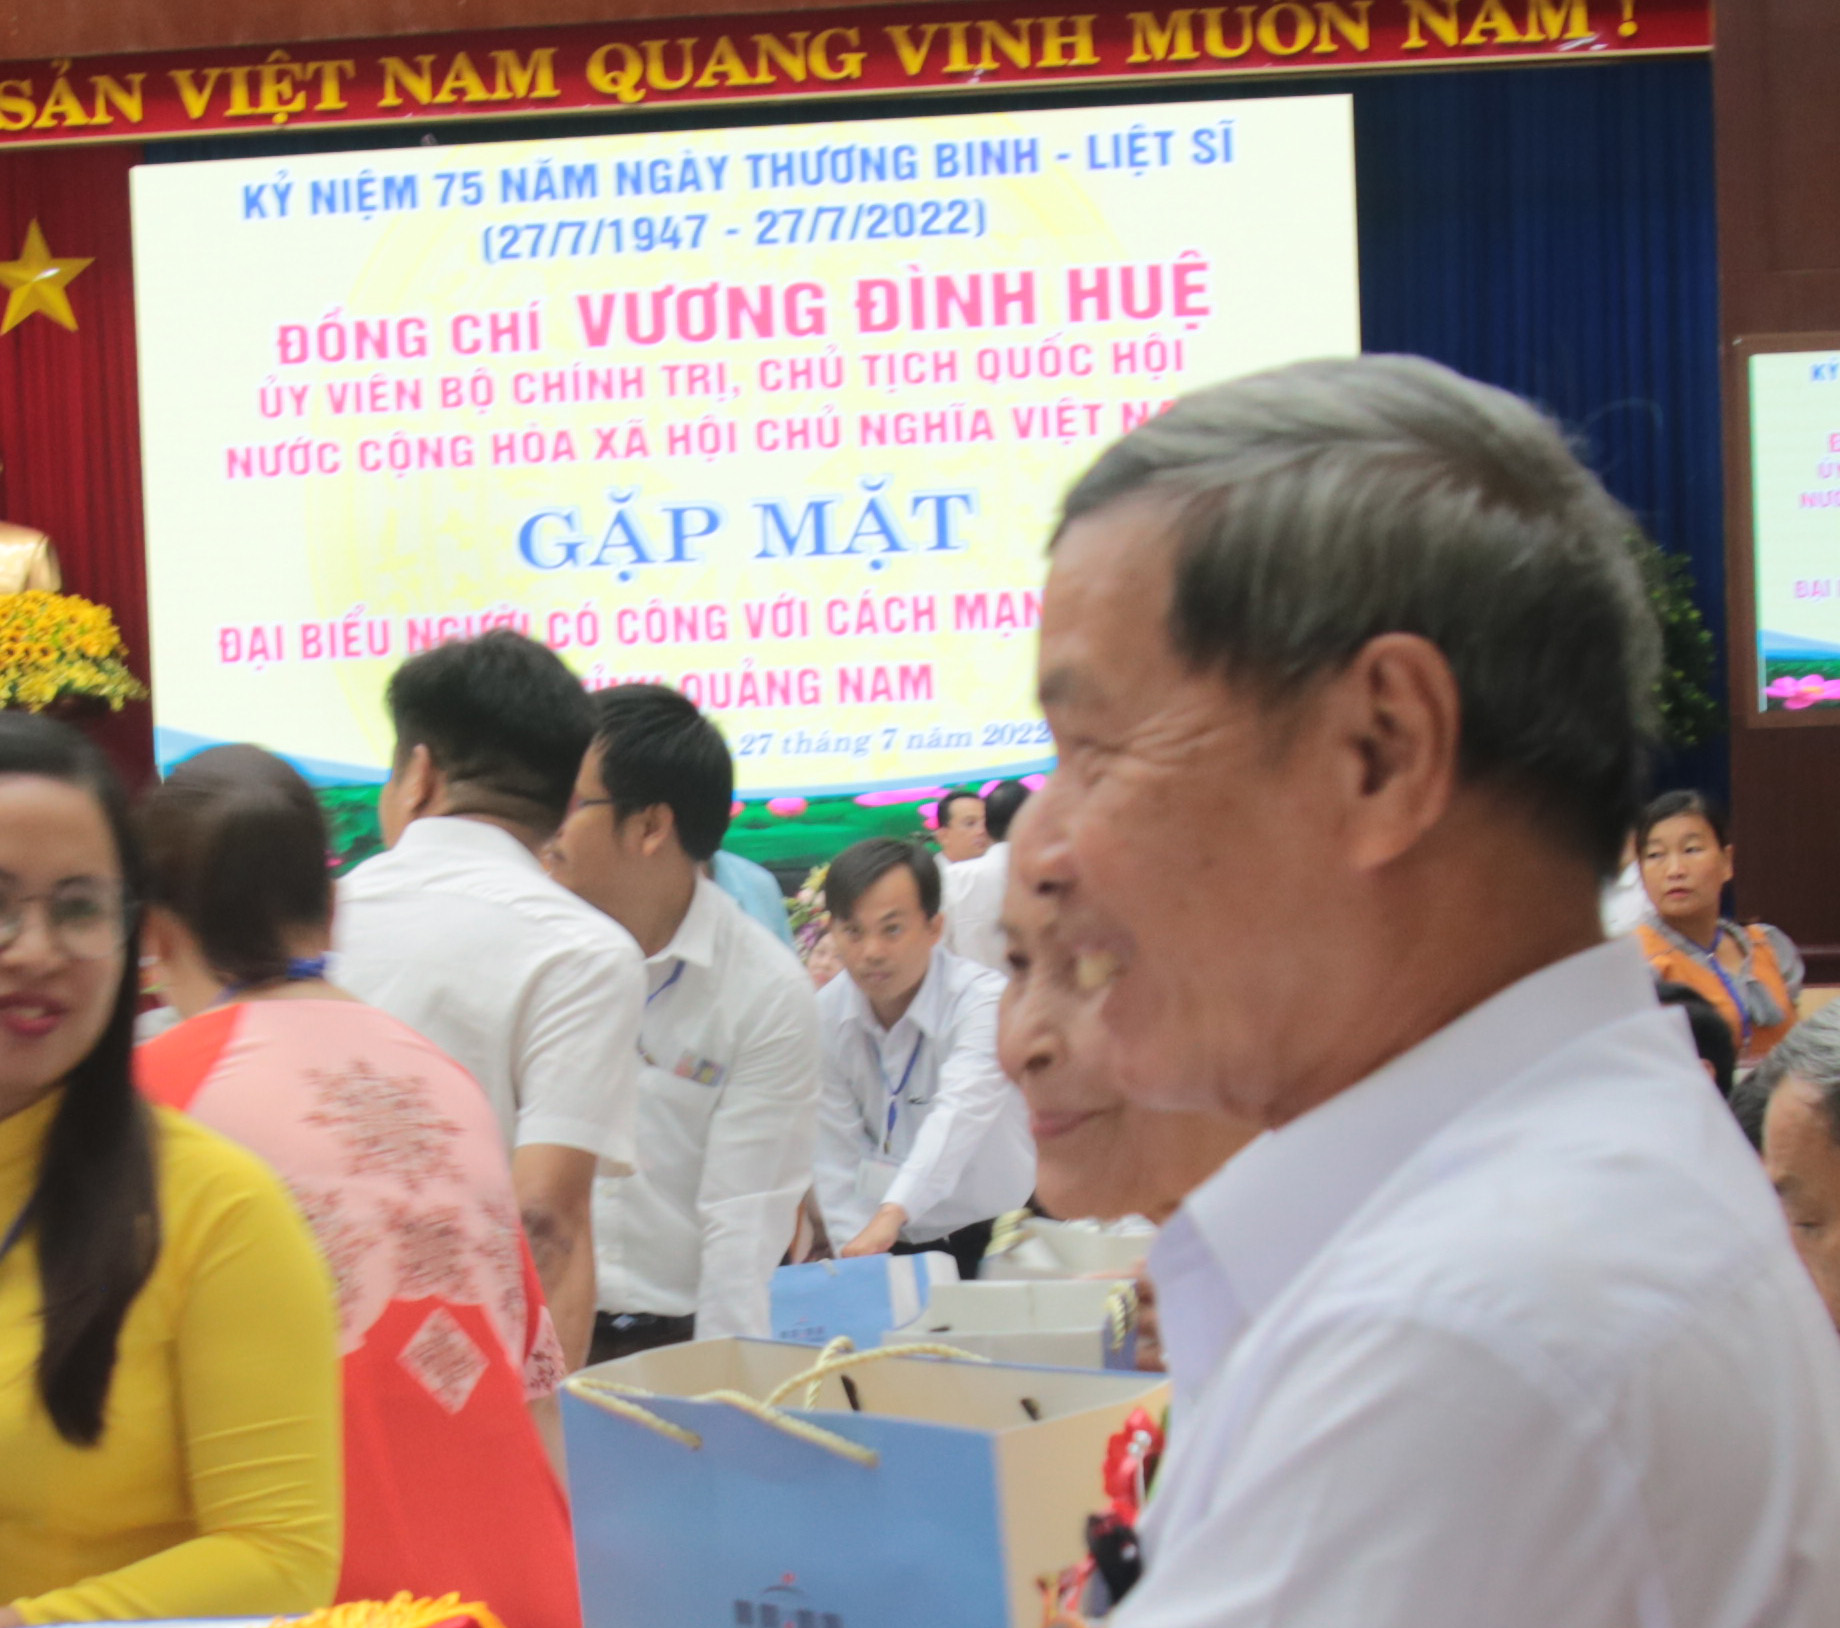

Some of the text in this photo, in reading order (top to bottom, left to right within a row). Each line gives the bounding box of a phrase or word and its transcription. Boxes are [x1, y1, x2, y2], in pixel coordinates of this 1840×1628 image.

[168, 48, 356, 125] VIỆT
[376, 47, 561, 108] NAM
[585, 27, 868, 104] QUANG
[883, 14, 1101, 77] VINH
[241, 169, 293, 220] KỶ
[310, 168, 419, 221] NIỆM
[432, 170, 484, 208] 75
[500, 157, 597, 203] NĂM
[615, 150, 729, 196] NGÀY
[744, 143, 919, 189] THƯƠNG
[934, 137, 1039, 180] BINH
[1087, 123, 1175, 177] LIỆT
[1191, 118, 1236, 166] SĨ
[483, 213, 709, 264] (27/7/1947
[755, 197, 987, 244] 27/7/2022)
[276, 249, 1210, 365] ĐỒNG CHÍ VƯƠNG ĐÌNH HUỆ
[258, 332, 1185, 420] ỦY VIÊN BỘ CHÍNH TRỊ, CHỦ TỊCH QUỐC HỘI
[225, 436, 341, 479] NƯỚC
[358, 430, 475, 479] CỘNG
[592, 418, 649, 462] XÃ
[667, 415, 737, 463] HỘI
[755, 404, 842, 452] CHỦ
[858, 402, 996, 448] NGHĨA
[1011, 397, 1103, 446] VIỆT
[518, 477, 972, 583] GẶP MẶT
[218, 623, 284, 671] ĐẠI
[300, 603, 390, 659] BIỂU
[547, 601, 600, 650] CÓ
[617, 598, 728, 647] CÔNG
[744, 591, 809, 640] VỚI
[826, 588, 936, 636] CÁCH
[954, 590, 1045, 639] MẠN
[837, 663, 933, 704] NAM
